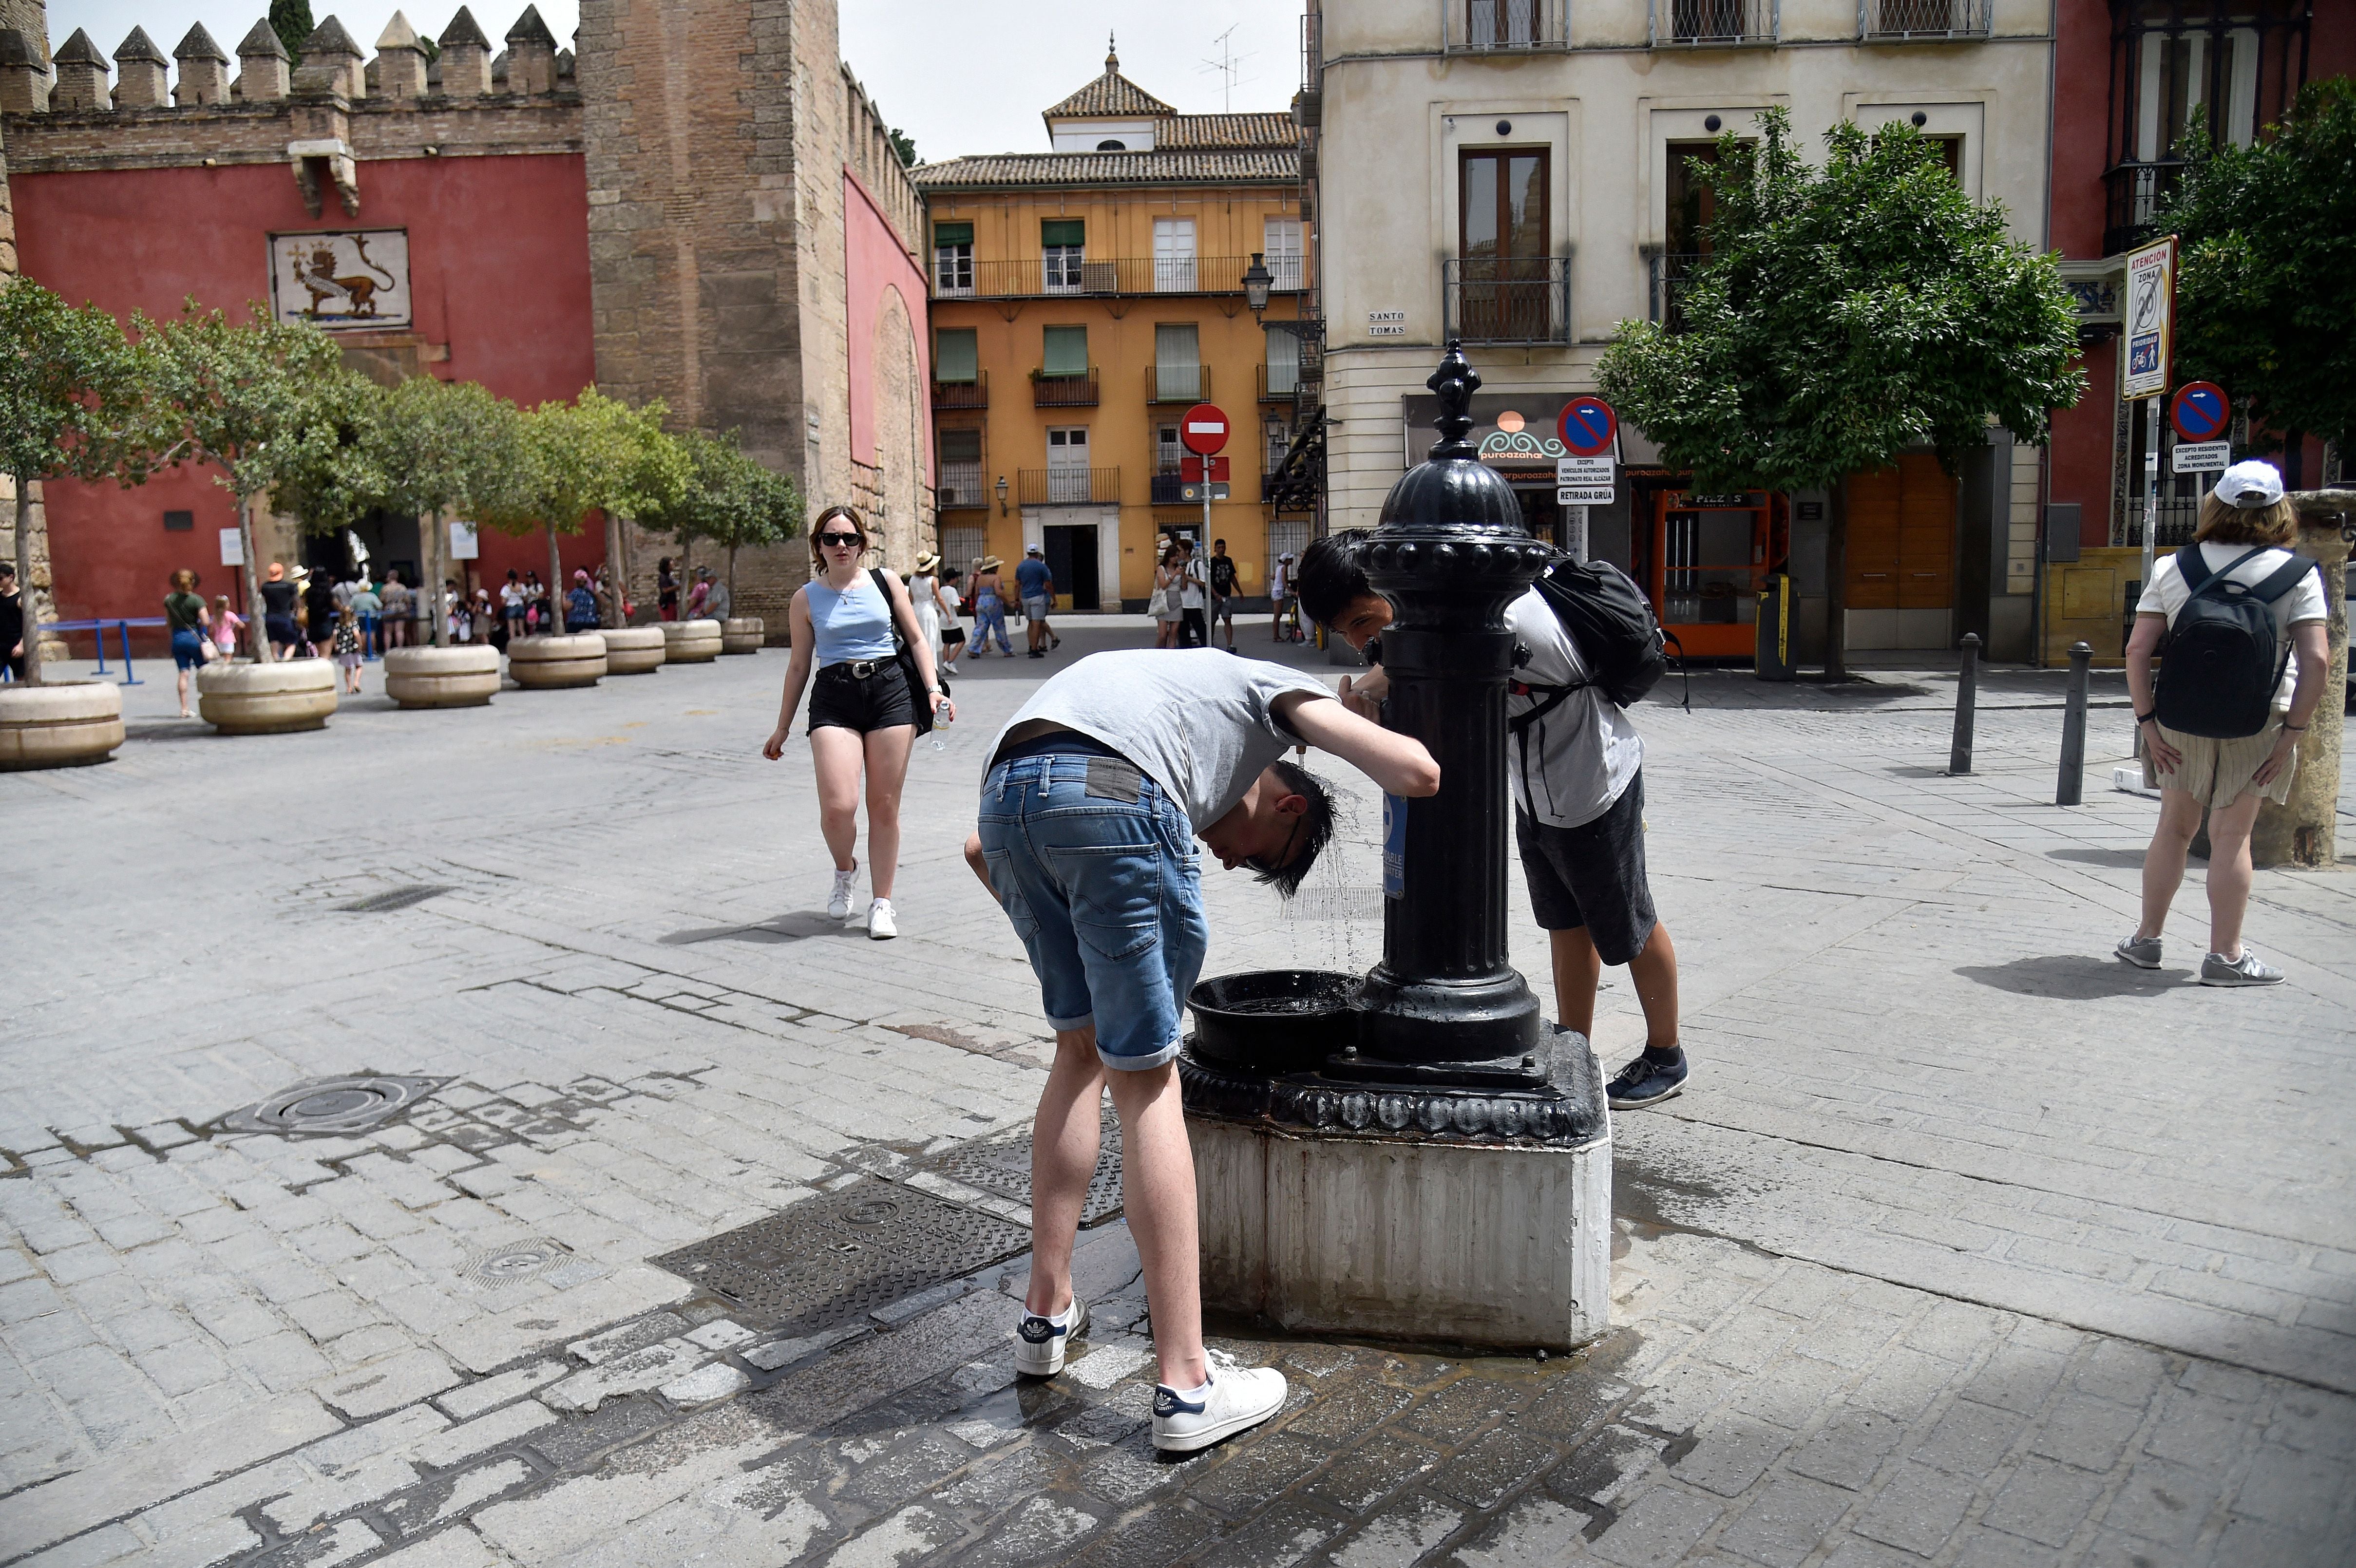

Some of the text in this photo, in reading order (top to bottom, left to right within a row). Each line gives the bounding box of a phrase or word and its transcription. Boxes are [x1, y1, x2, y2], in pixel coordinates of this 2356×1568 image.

[2131, 248, 2166, 271] ATENCIÓN
[2138, 270, 2156, 283] ZONA
[2132, 336, 2158, 348] PRIORIDAD
[1481, 452, 1543, 460] puroazahar
[1594, 489, 1612, 499] GRÚA
[1033, 1330, 1048, 1338] smith
